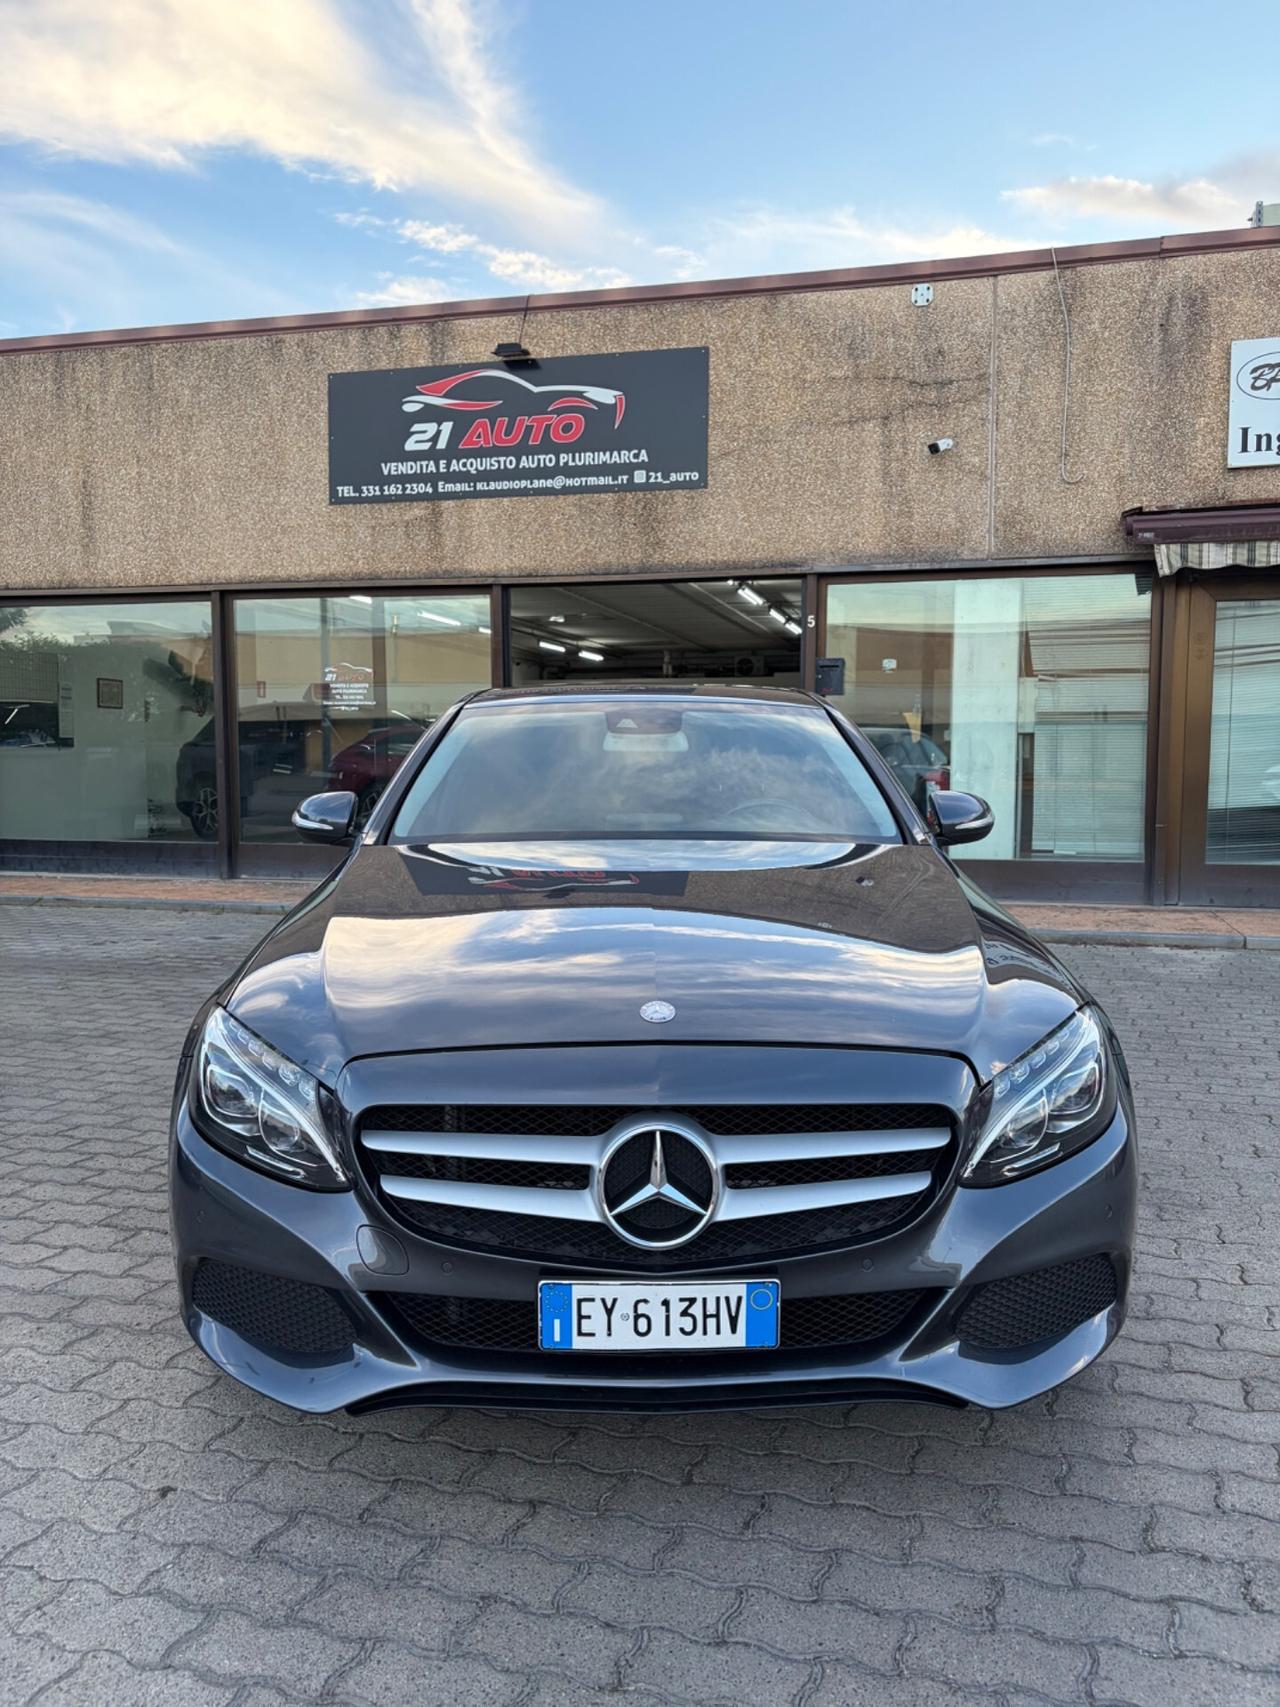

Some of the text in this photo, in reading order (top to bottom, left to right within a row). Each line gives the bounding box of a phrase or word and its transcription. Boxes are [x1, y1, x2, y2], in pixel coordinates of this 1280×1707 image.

[404, 413, 585, 451] 21 AUTO
[1239, 426, 1280, 456] In
[381, 449, 648, 475] VENDITA E ACQUISTO AUTO PLURIMARCA
[337, 486, 359, 497] TEL.
[361, 485, 381, 497] 331
[383, 484, 402, 495] 162
[405, 482, 433, 494] 2304
[807, 615, 816, 628] 5
[576, 1295, 743, 1338] EY 613HV
